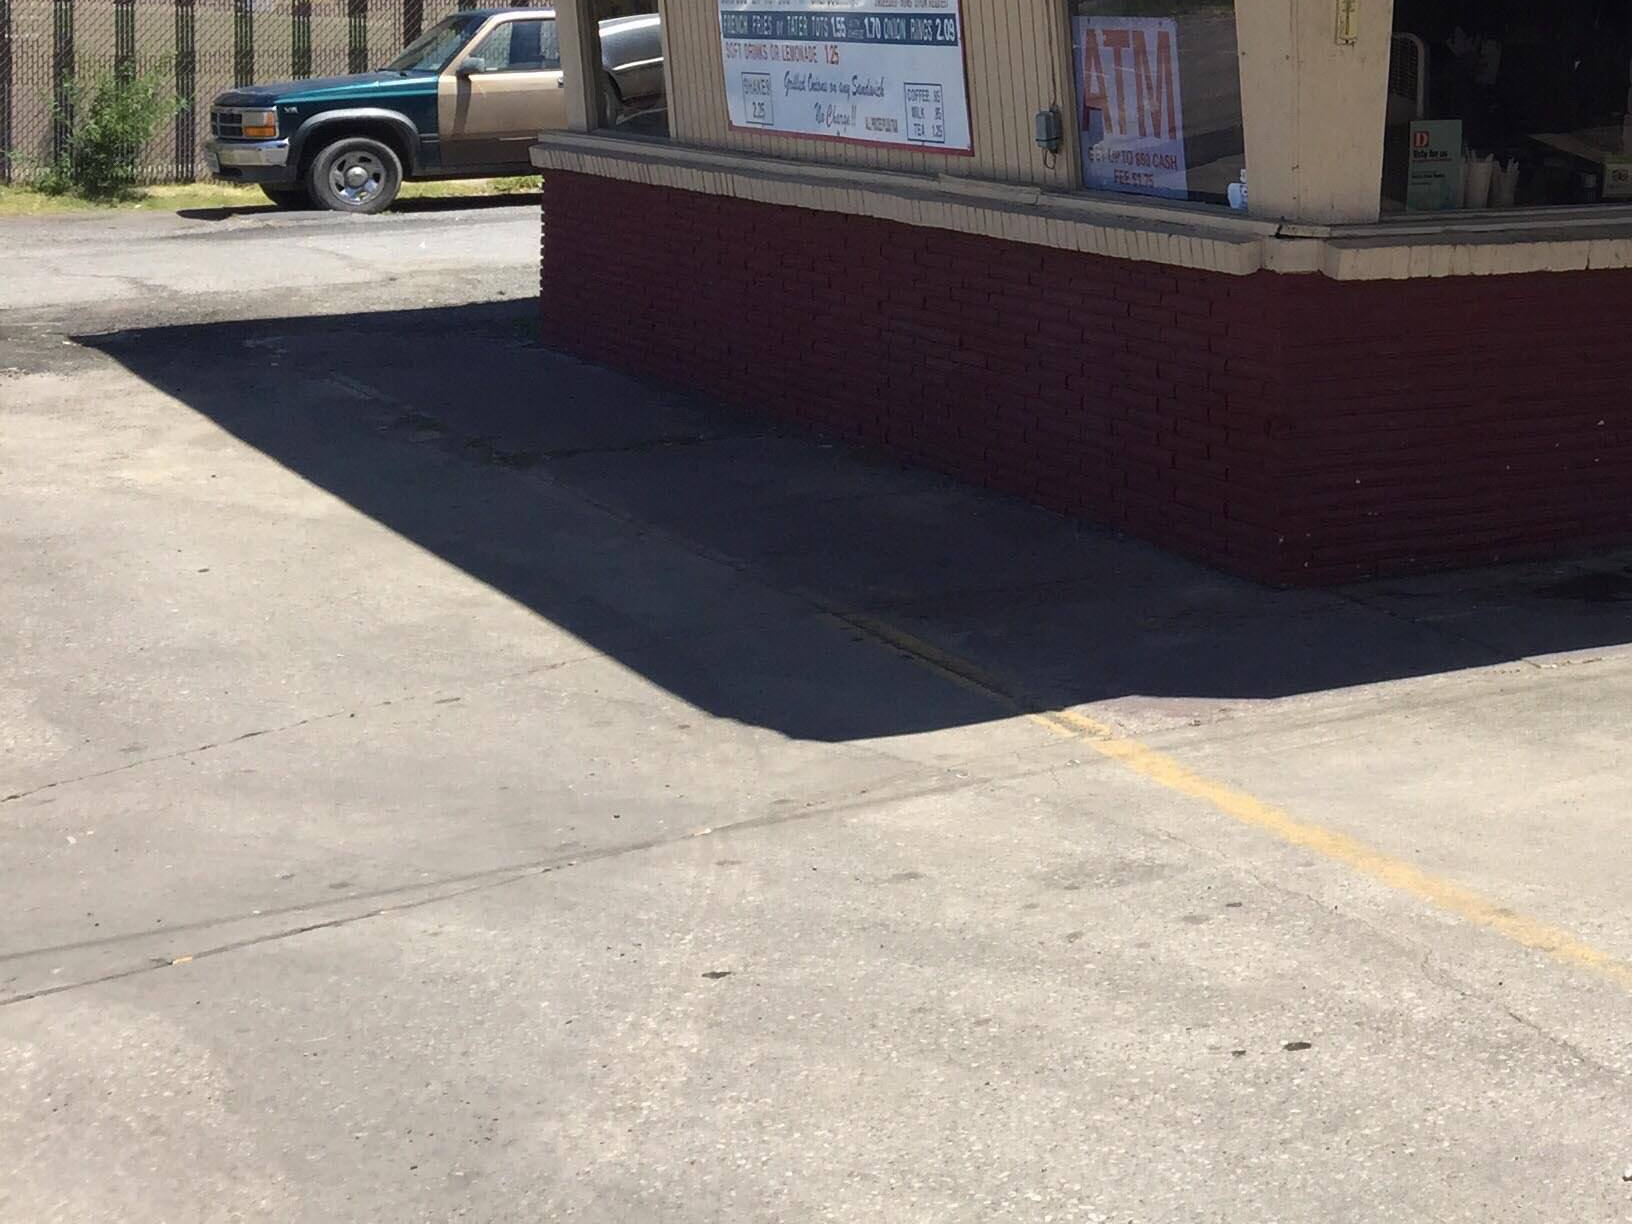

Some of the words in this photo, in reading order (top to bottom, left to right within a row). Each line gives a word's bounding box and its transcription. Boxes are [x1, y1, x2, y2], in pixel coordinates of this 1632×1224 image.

[723, 14, 748, 35] FRENCH
[751, 15, 773, 36] FRIES
[787, 15, 808, 37] TATER
[811, 16, 829, 38] TOTS
[830, 15, 847, 38] 1.55
[864, 16, 881, 39] 1.70
[883, 16, 906, 41] ONION
[910, 17, 933, 41] RINGS
[935, 17, 956, 42] 2.09
[725, 41, 741, 59] SOFT
[743, 42, 769, 61] DRINKS
[769, 43, 780, 61] OR
[781, 43, 818, 64] LEMONADE
[743, 78, 771, 96] SHAKES
[851, 74, 885, 98] Sandwich
[1081, 28, 1178, 141] ATM
[906, 88, 930, 103] COFFEE
[913, 122, 926, 137] TEA
[1415, 132, 1429, 147] D
[1121, 150, 1133, 165] TO
[1152, 153, 1178, 171] CASH
